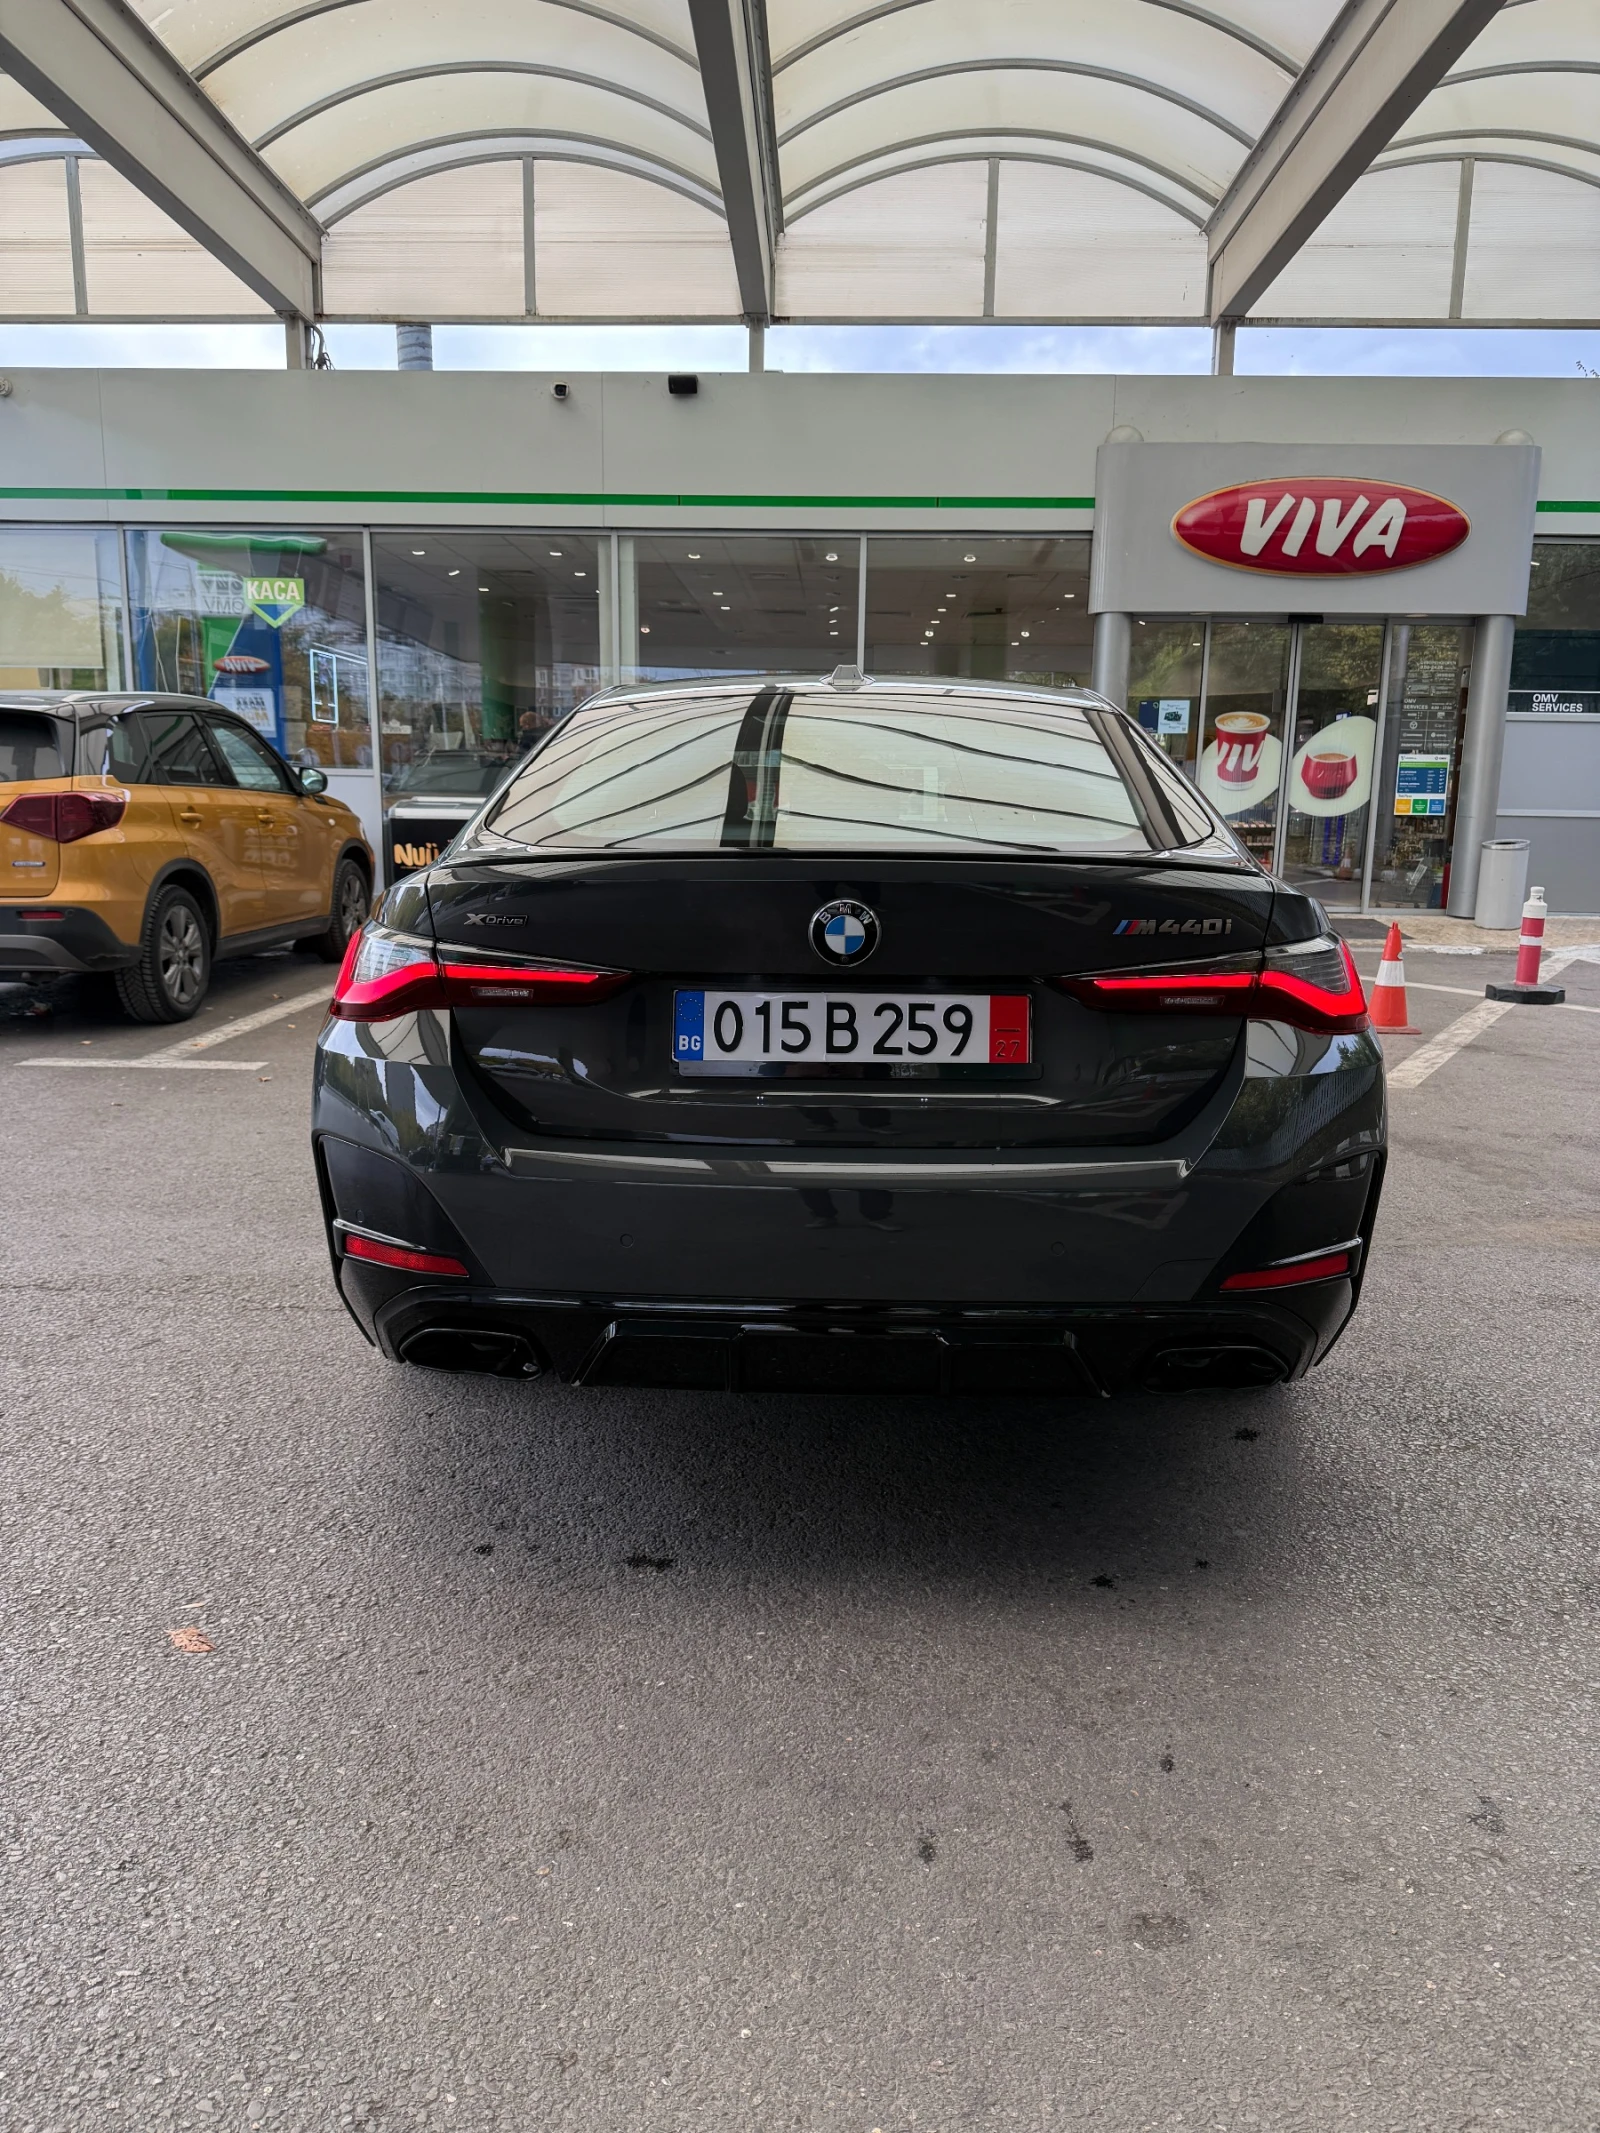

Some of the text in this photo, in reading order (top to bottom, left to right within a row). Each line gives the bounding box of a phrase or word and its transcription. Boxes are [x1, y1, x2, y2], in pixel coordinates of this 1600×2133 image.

[1240, 493, 1407, 559] VIVA
[246, 580, 301, 601] КАСА
[1532, 693, 1559, 703] OMV
[1531, 702, 1584, 713] SERVICES
[818, 903, 873, 925] BMW
[1130, 918, 1233, 936] M440i
[678, 1034, 702, 1052] BG
